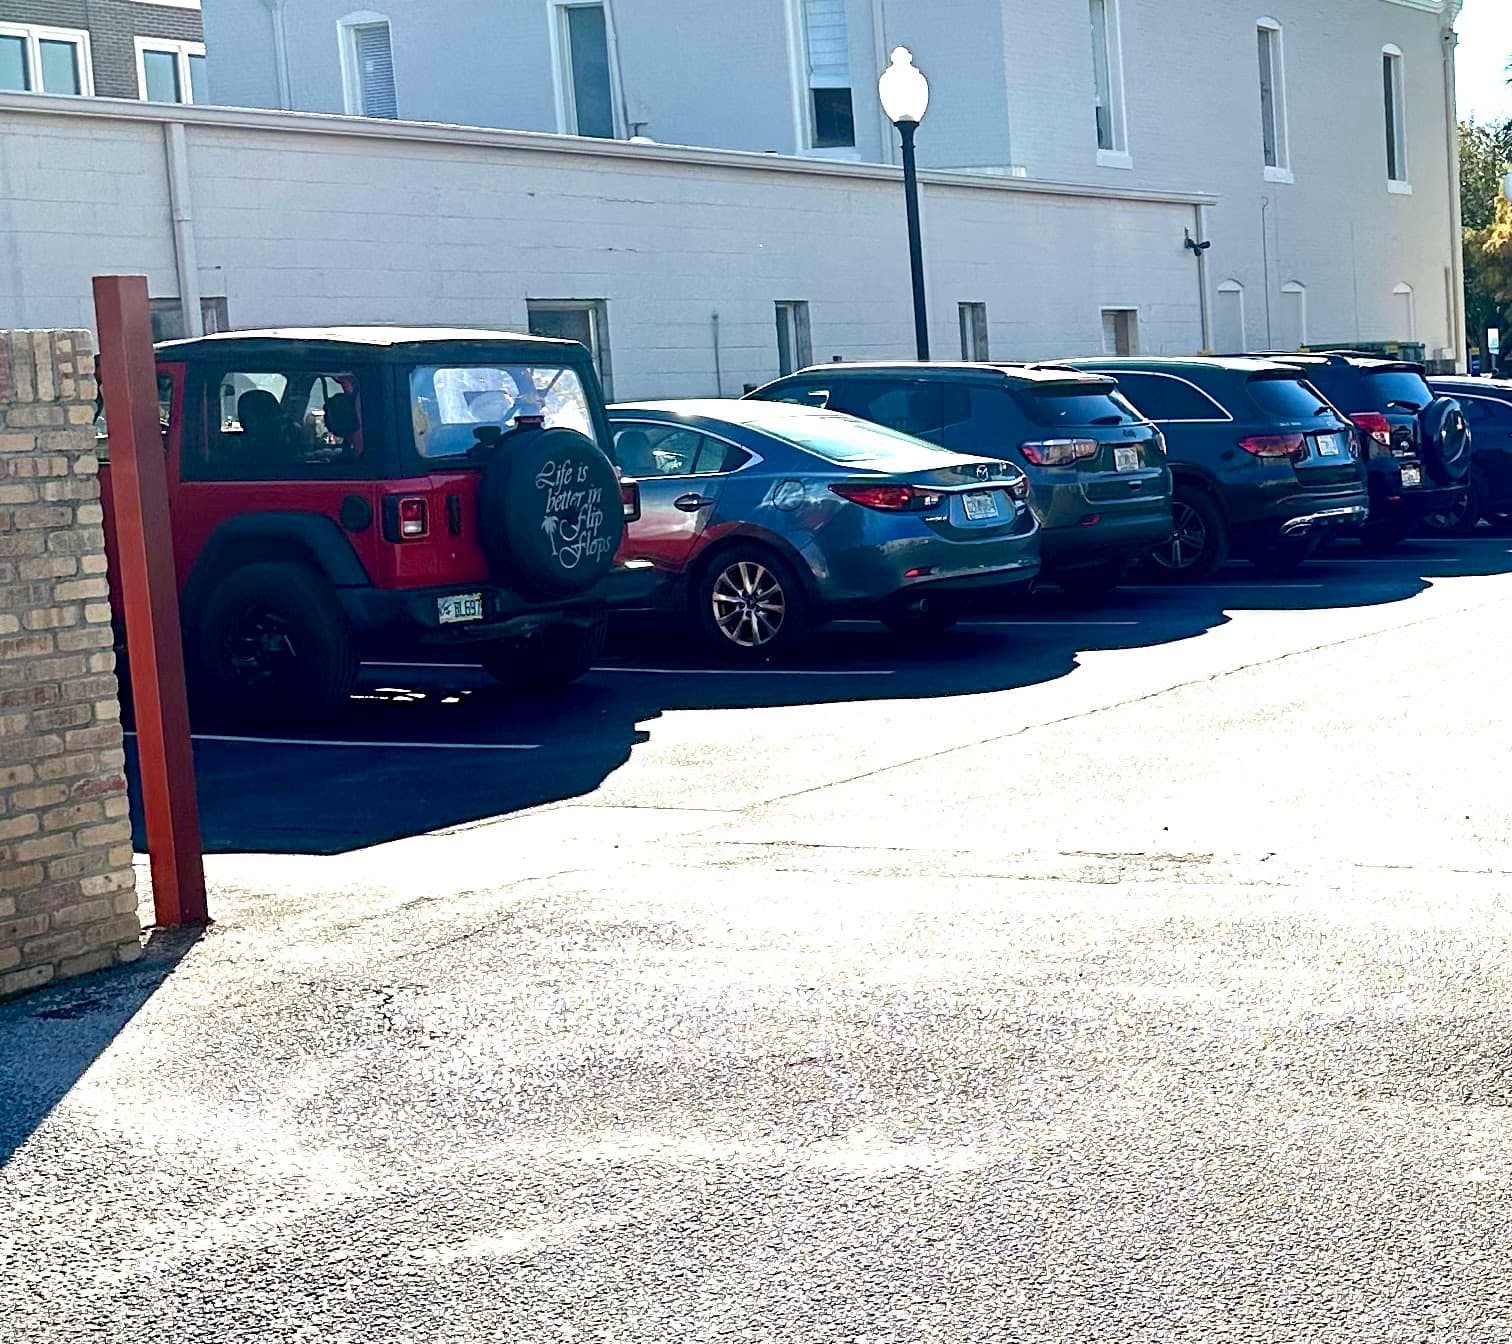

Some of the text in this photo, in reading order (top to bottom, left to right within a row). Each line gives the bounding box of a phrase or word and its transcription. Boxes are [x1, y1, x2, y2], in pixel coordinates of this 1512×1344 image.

[536, 460, 589, 495] Life is
[546, 484, 602, 514] better in
